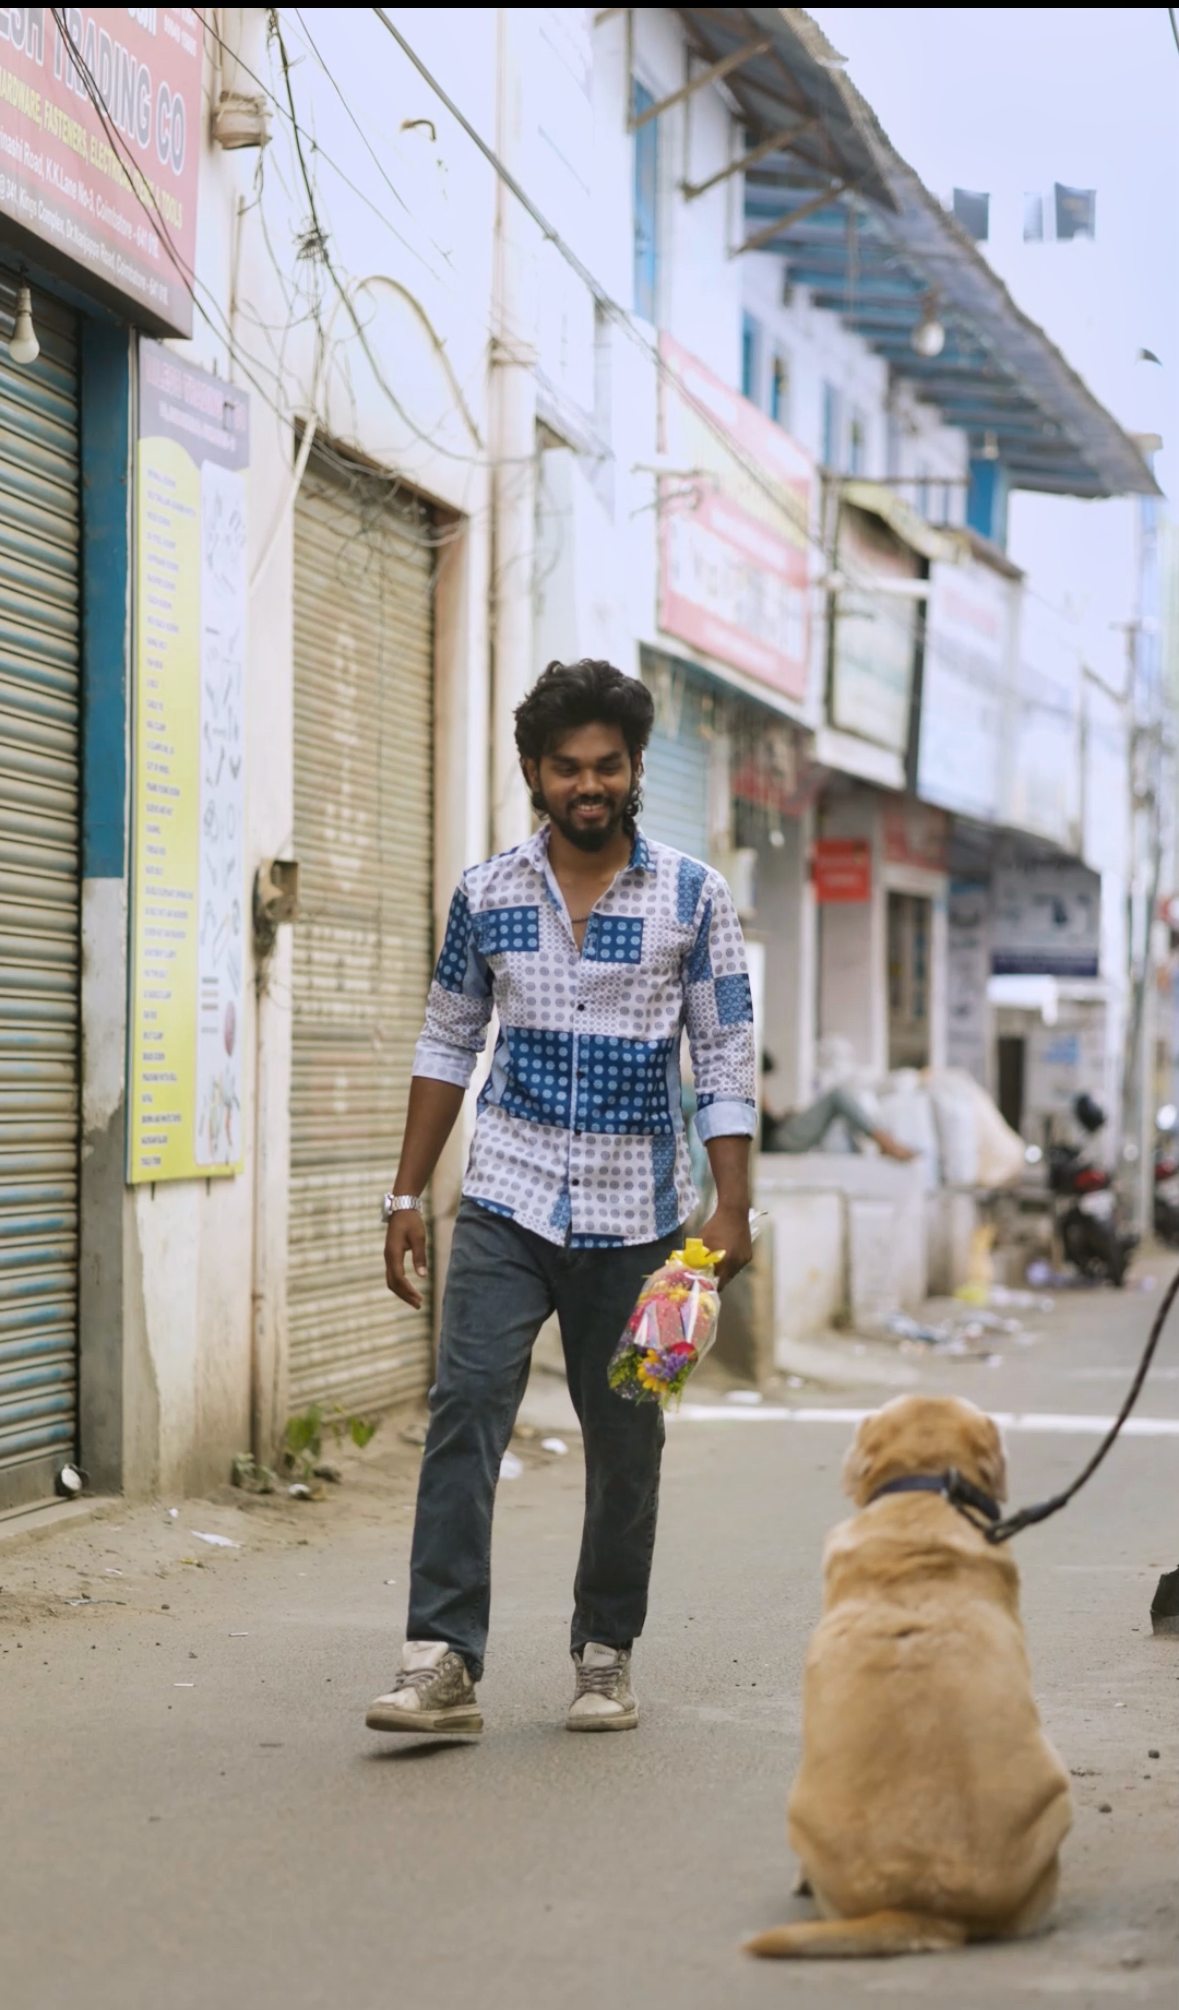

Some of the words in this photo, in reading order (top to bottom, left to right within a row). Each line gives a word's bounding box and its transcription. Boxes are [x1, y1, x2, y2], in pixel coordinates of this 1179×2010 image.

[51, 8, 152, 149] TRADING
[157, 80, 186, 175] CO
[24, 140, 45, 180] Road,
[44, 99, 89, 165] FASTENERS,
